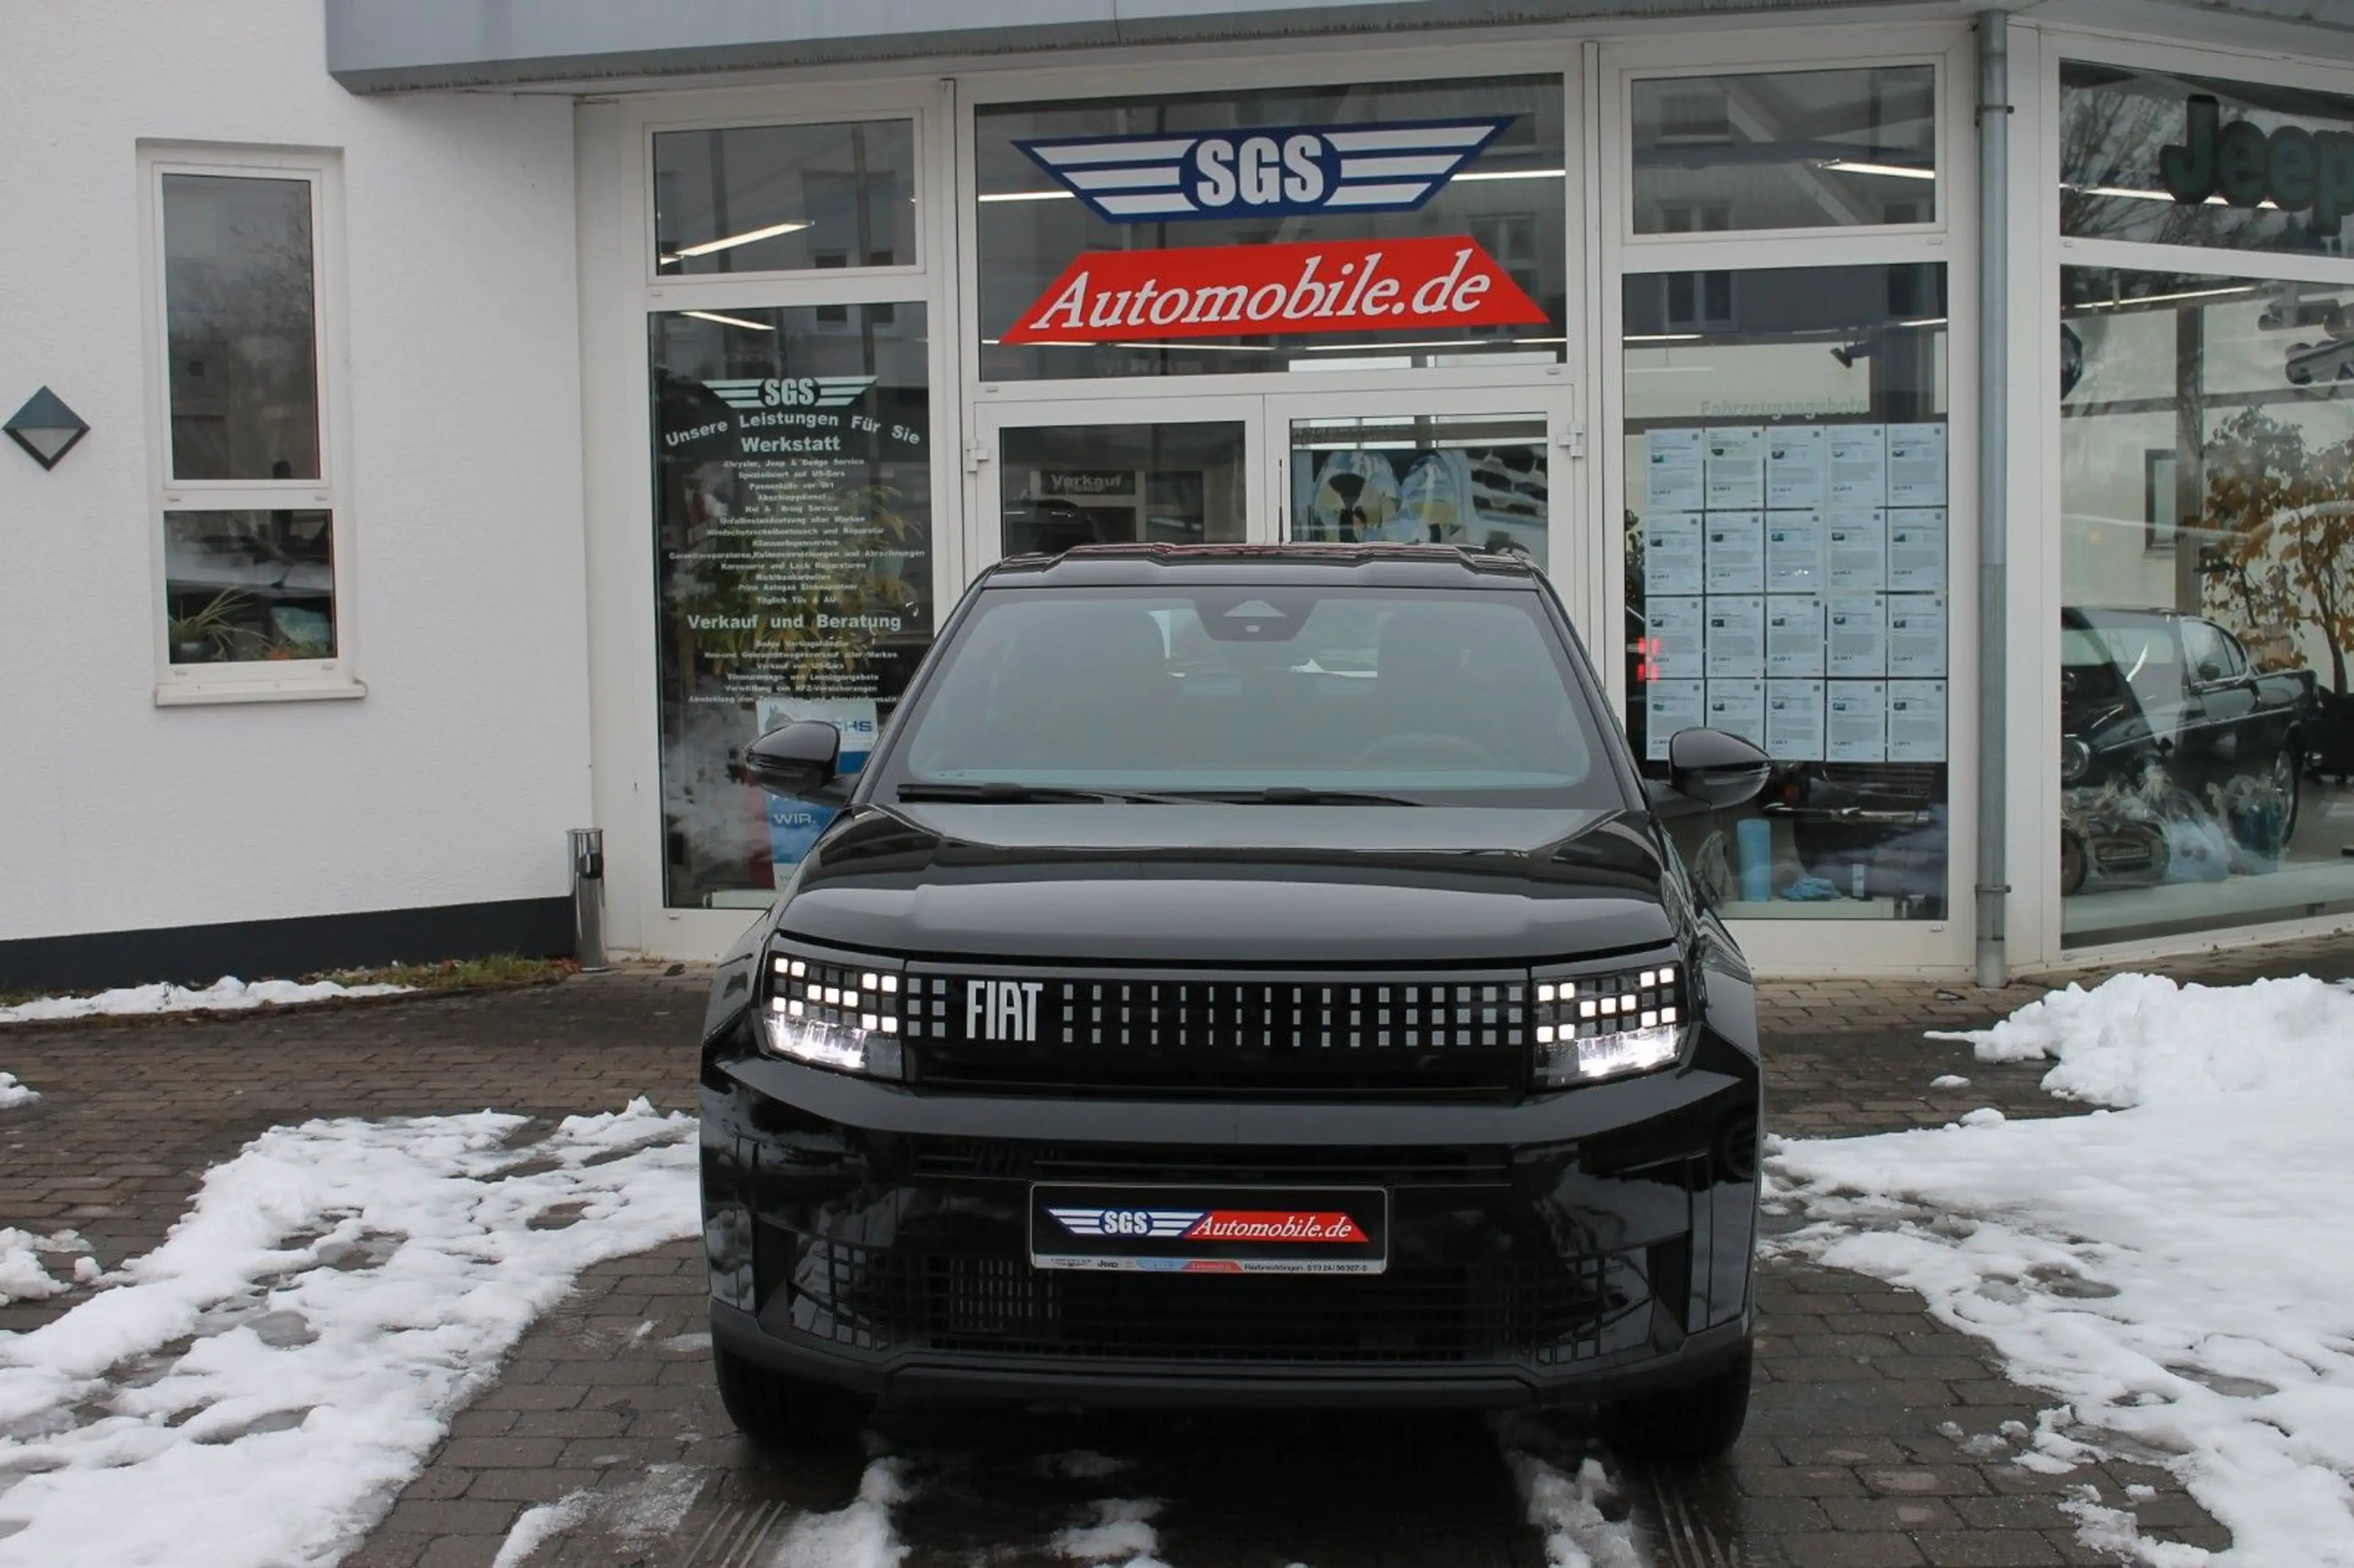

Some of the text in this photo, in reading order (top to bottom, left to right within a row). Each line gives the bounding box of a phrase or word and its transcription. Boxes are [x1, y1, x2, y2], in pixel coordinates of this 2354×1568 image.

[1195, 134, 1325, 207] SGS
[2158, 94, 2354, 237] Jeep
[1029, 248, 1491, 330] Automobile.de
[764, 378, 815, 406] SGS
[666, 412, 920, 446] Unsere Leistungen Für Sie
[742, 436, 841, 452] Werkstatt
[1050, 474, 1122, 490] Verkauf
[688, 614, 902, 630] Verkauf und Beratung
[773, 813, 817, 824] WIR.
[966, 980, 1043, 1041] FIAT
[1104, 1211, 1352, 1238] SGS Automobile.de
